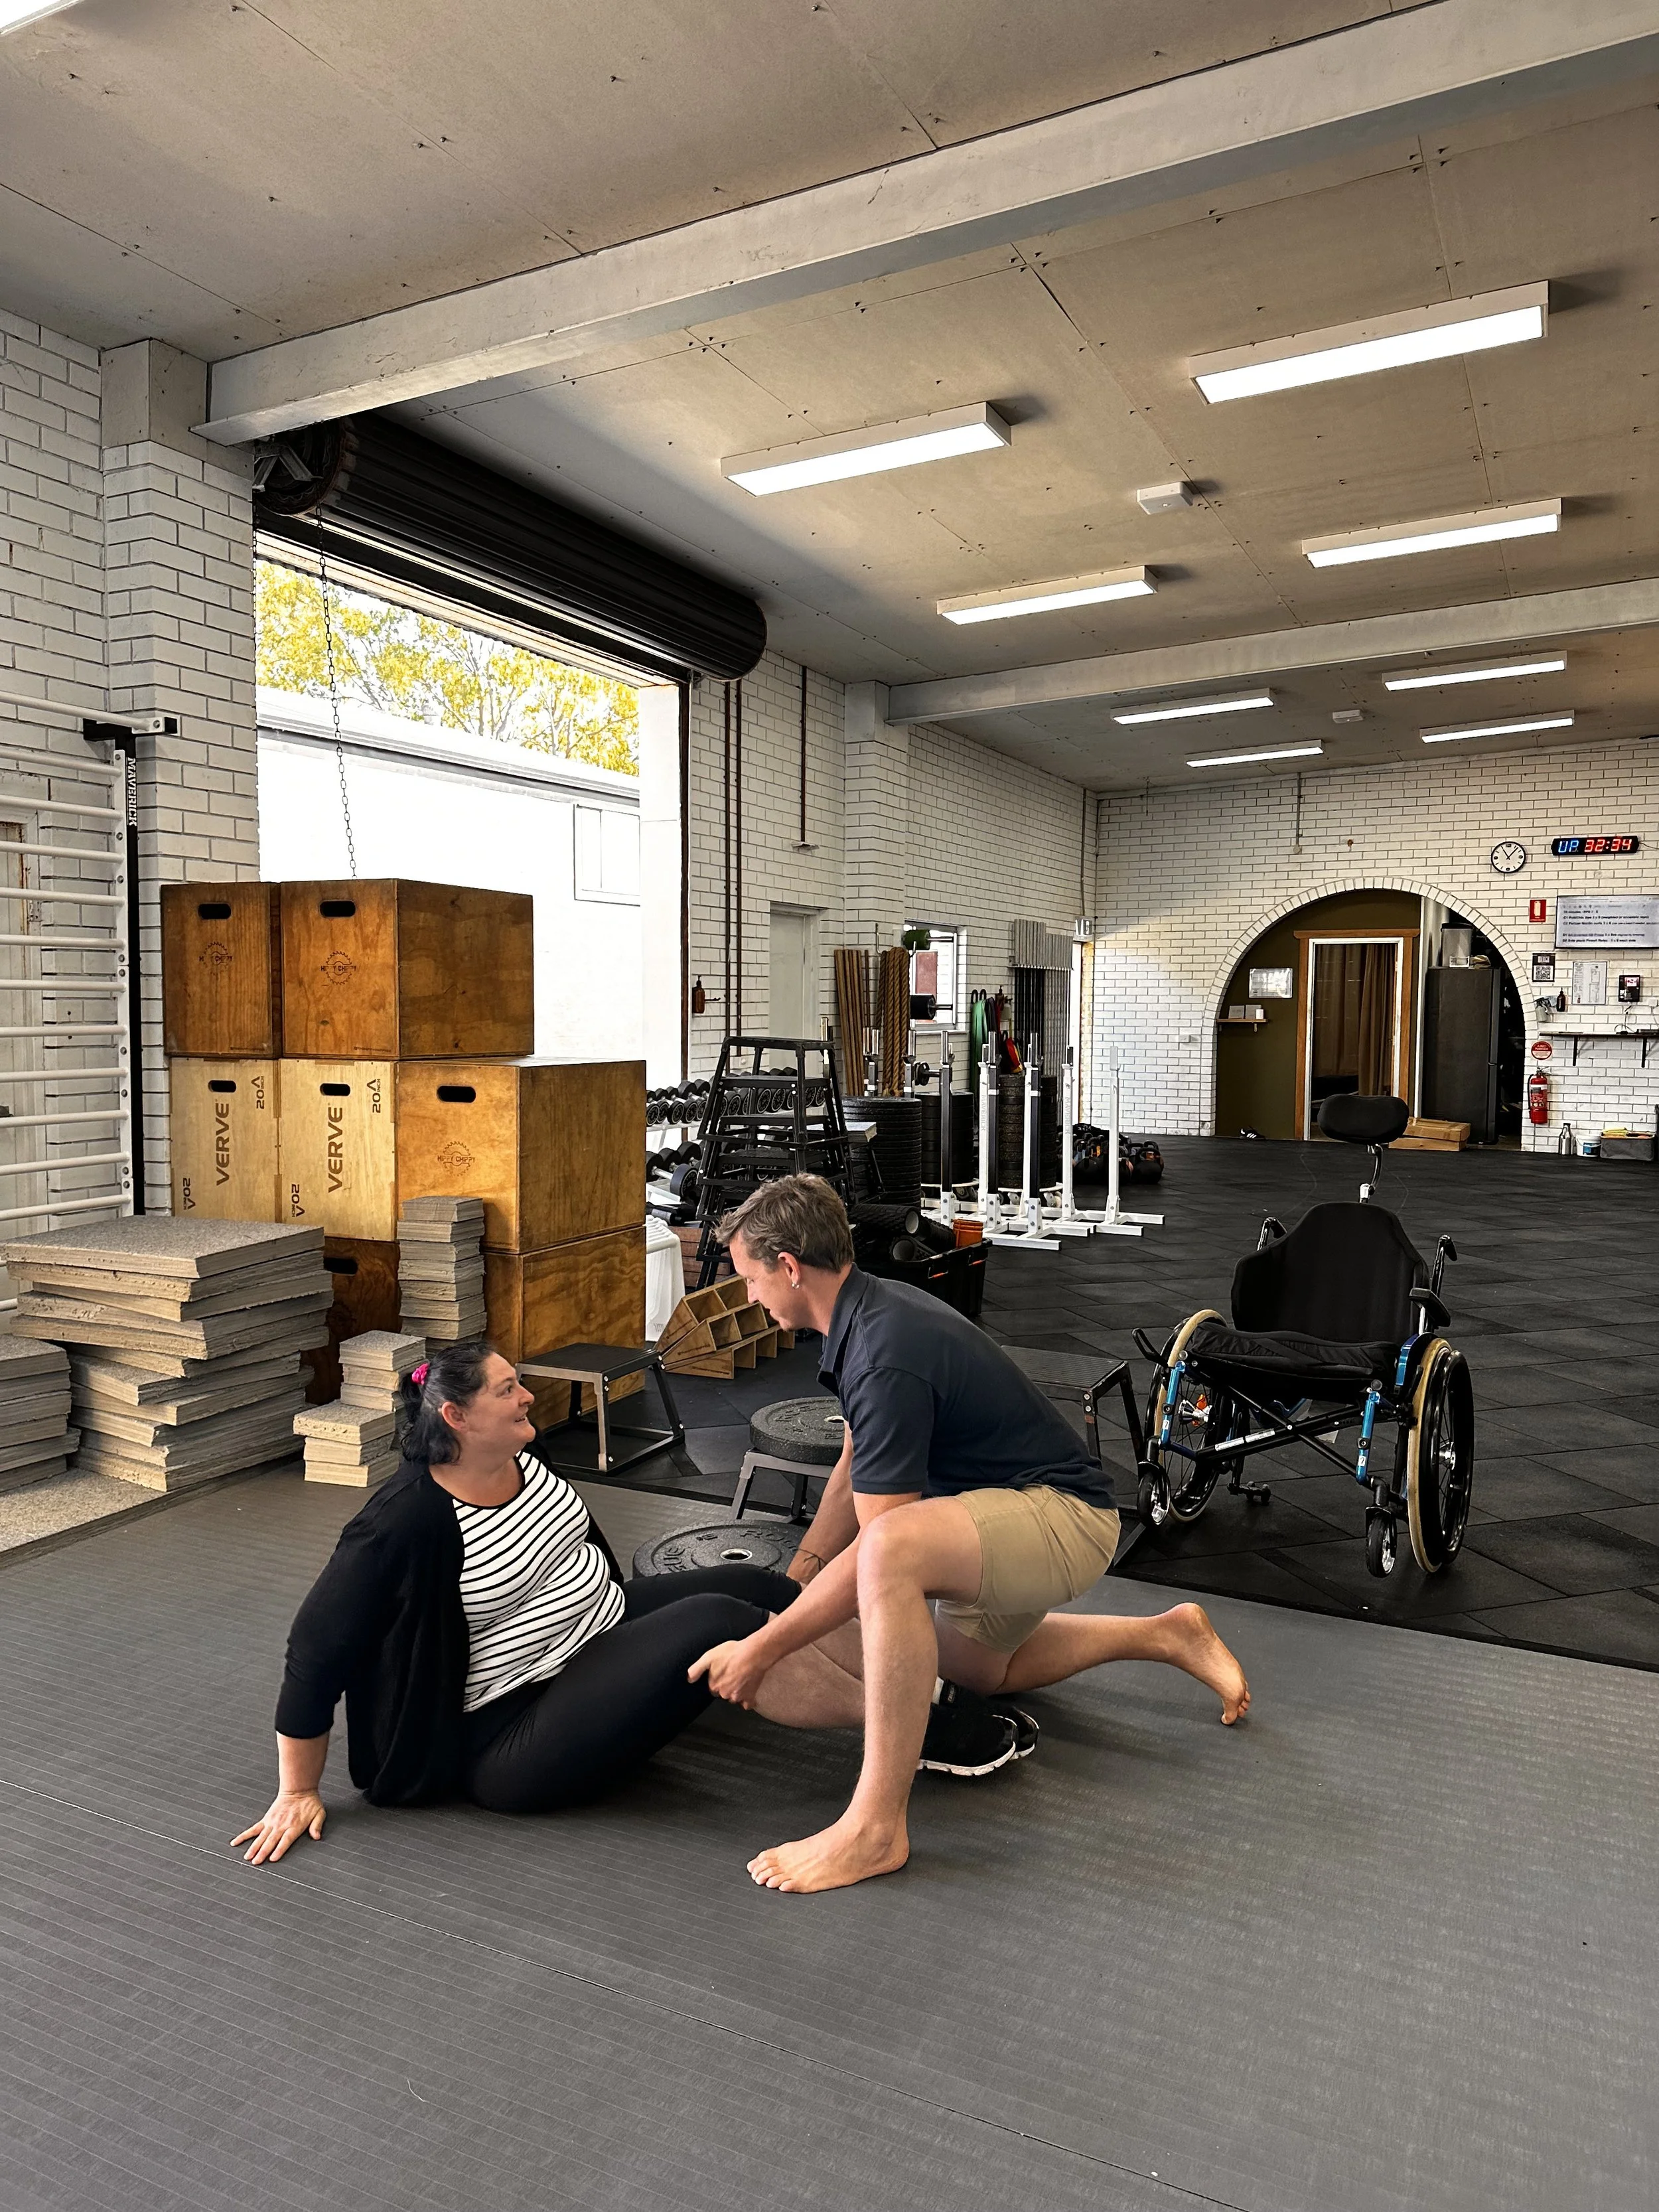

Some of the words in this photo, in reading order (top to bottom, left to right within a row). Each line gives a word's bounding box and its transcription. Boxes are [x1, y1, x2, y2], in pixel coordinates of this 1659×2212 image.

[127, 757, 137, 826] MAVERICK
[1557, 840, 1579, 853] UP
[1584, 838, 1632, 853] 32:34
[256, 1089, 265, 1109] 20
[372, 1092, 381, 1114] 20
[215, 1102, 230, 1186] VERVE
[328, 1106, 343, 1193] VERVE
[182, 1177, 191, 1197] 20
[291, 1183, 300, 1204] 20
